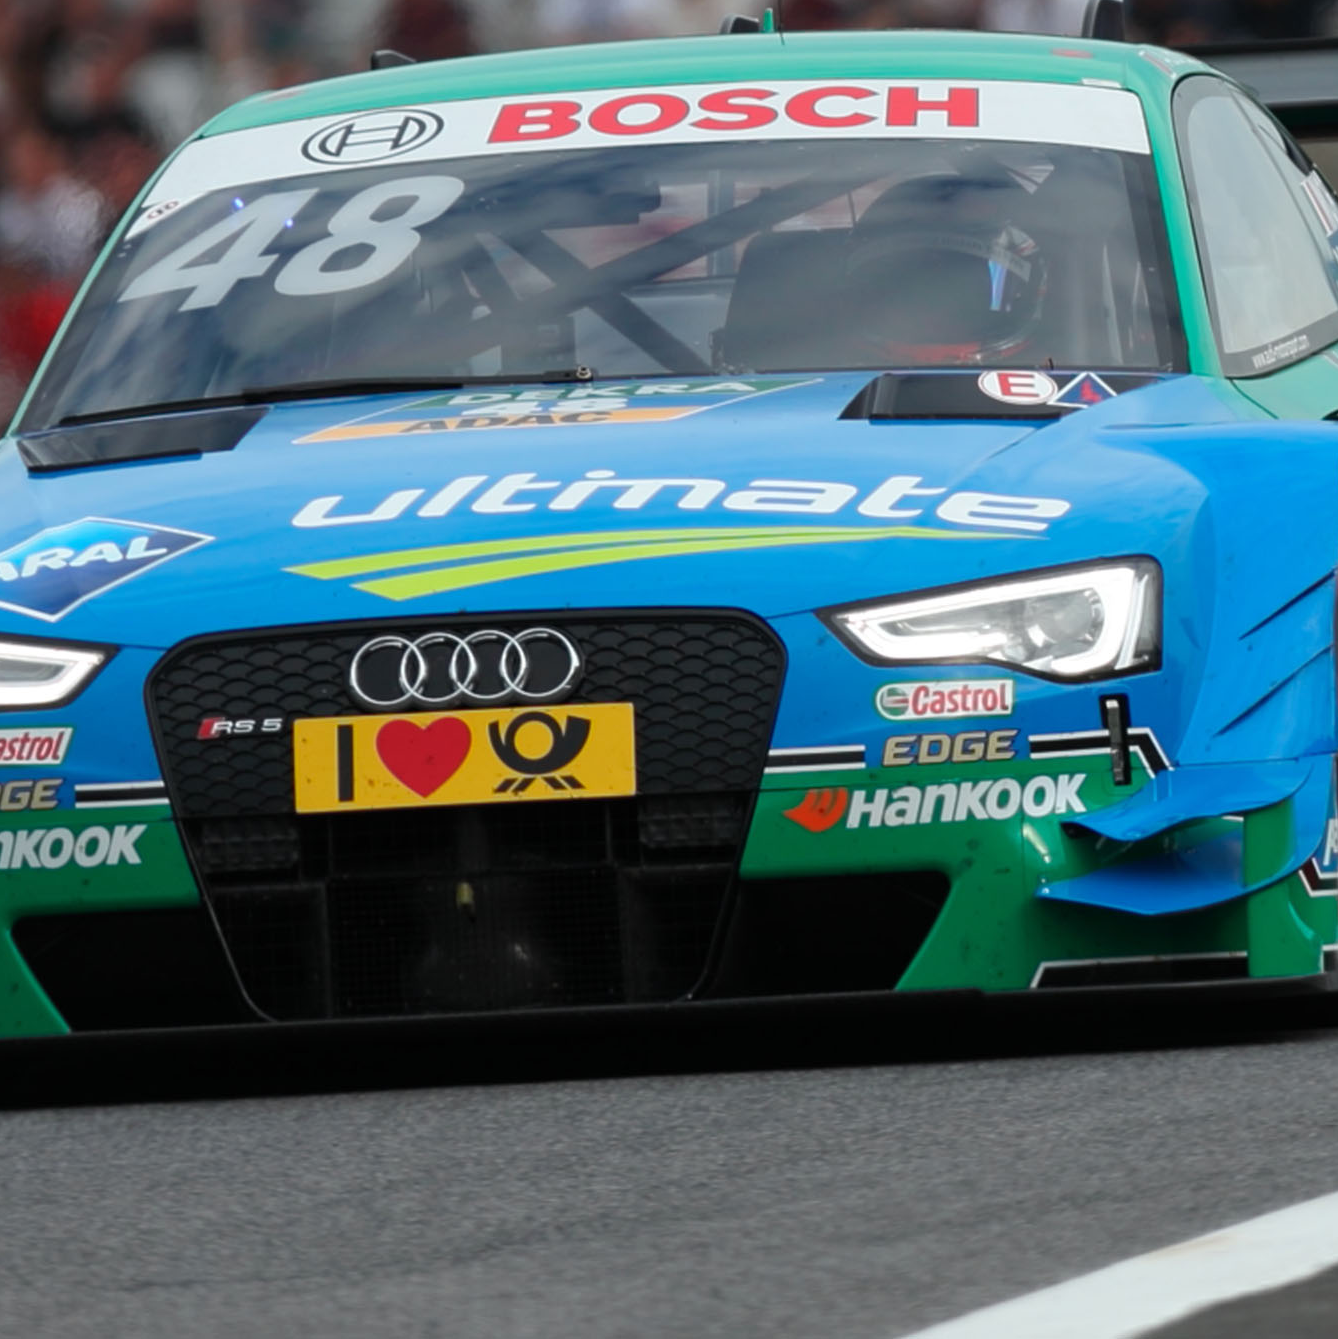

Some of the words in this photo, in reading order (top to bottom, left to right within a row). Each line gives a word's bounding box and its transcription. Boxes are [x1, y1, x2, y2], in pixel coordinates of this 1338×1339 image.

[487, 85, 980, 144] BOSCH
[117, 175, 465, 313] 48
[448, 381, 758, 406] DEKRA
[996, 372, 1041, 398] E
[398, 411, 612, 434] ADAC
[291, 470, 1072, 532] ultimate
[911, 683, 1009, 716] Castrol
[336, 723, 355, 804] I
[882, 728, 1021, 768] EDGE
